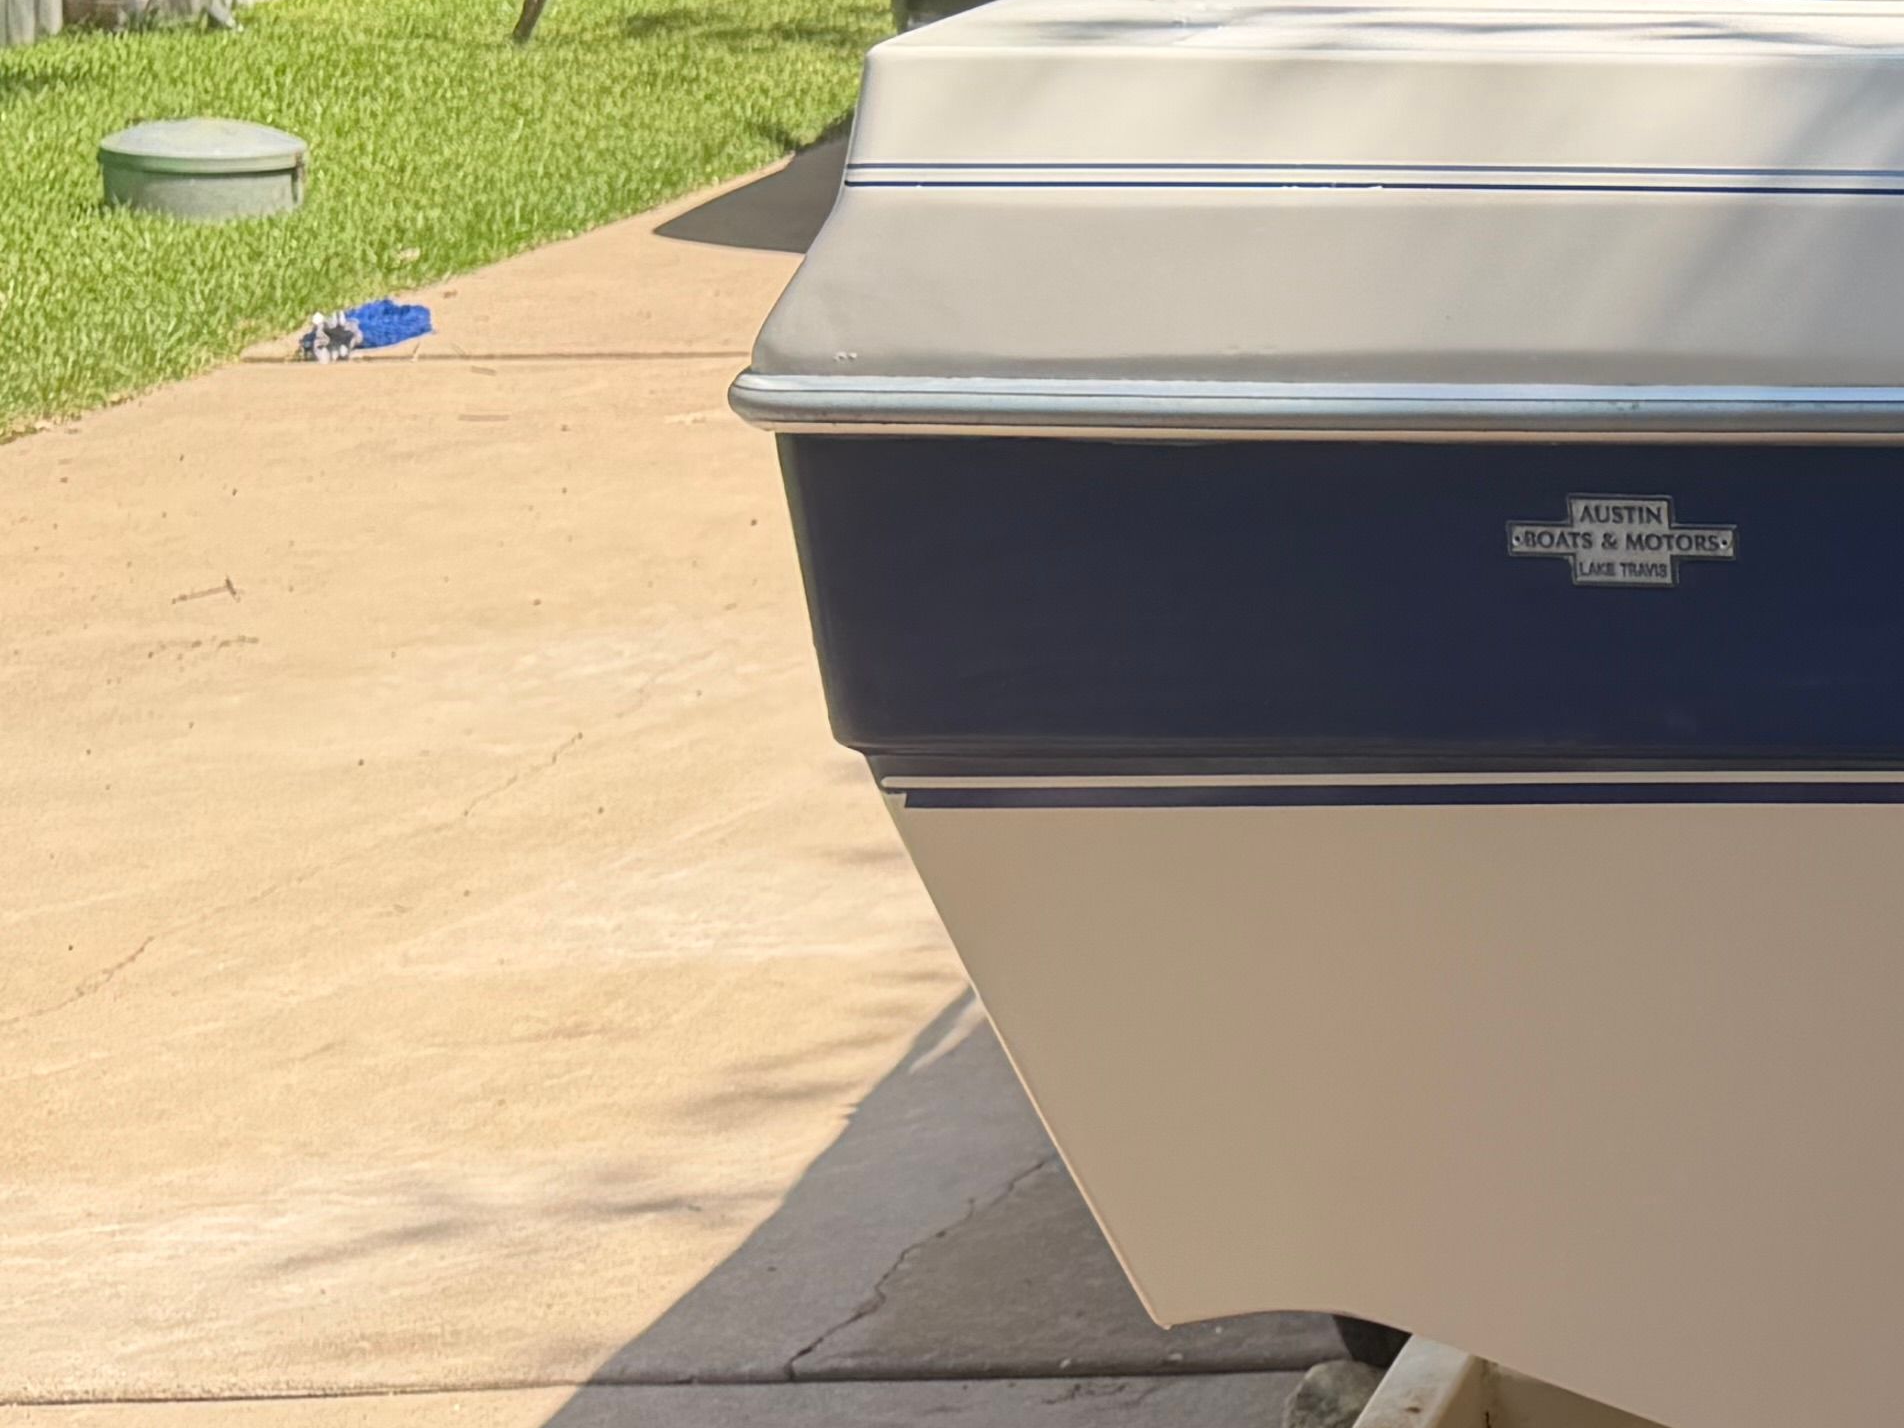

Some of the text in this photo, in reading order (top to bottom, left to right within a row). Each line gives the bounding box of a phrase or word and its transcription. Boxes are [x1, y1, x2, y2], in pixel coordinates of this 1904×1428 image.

[1580, 505, 1662, 524] AUSTIN
[1523, 531, 1719, 551] BOATS & MOTORS
[1579, 562, 1667, 578] LAKE TRAVIS
